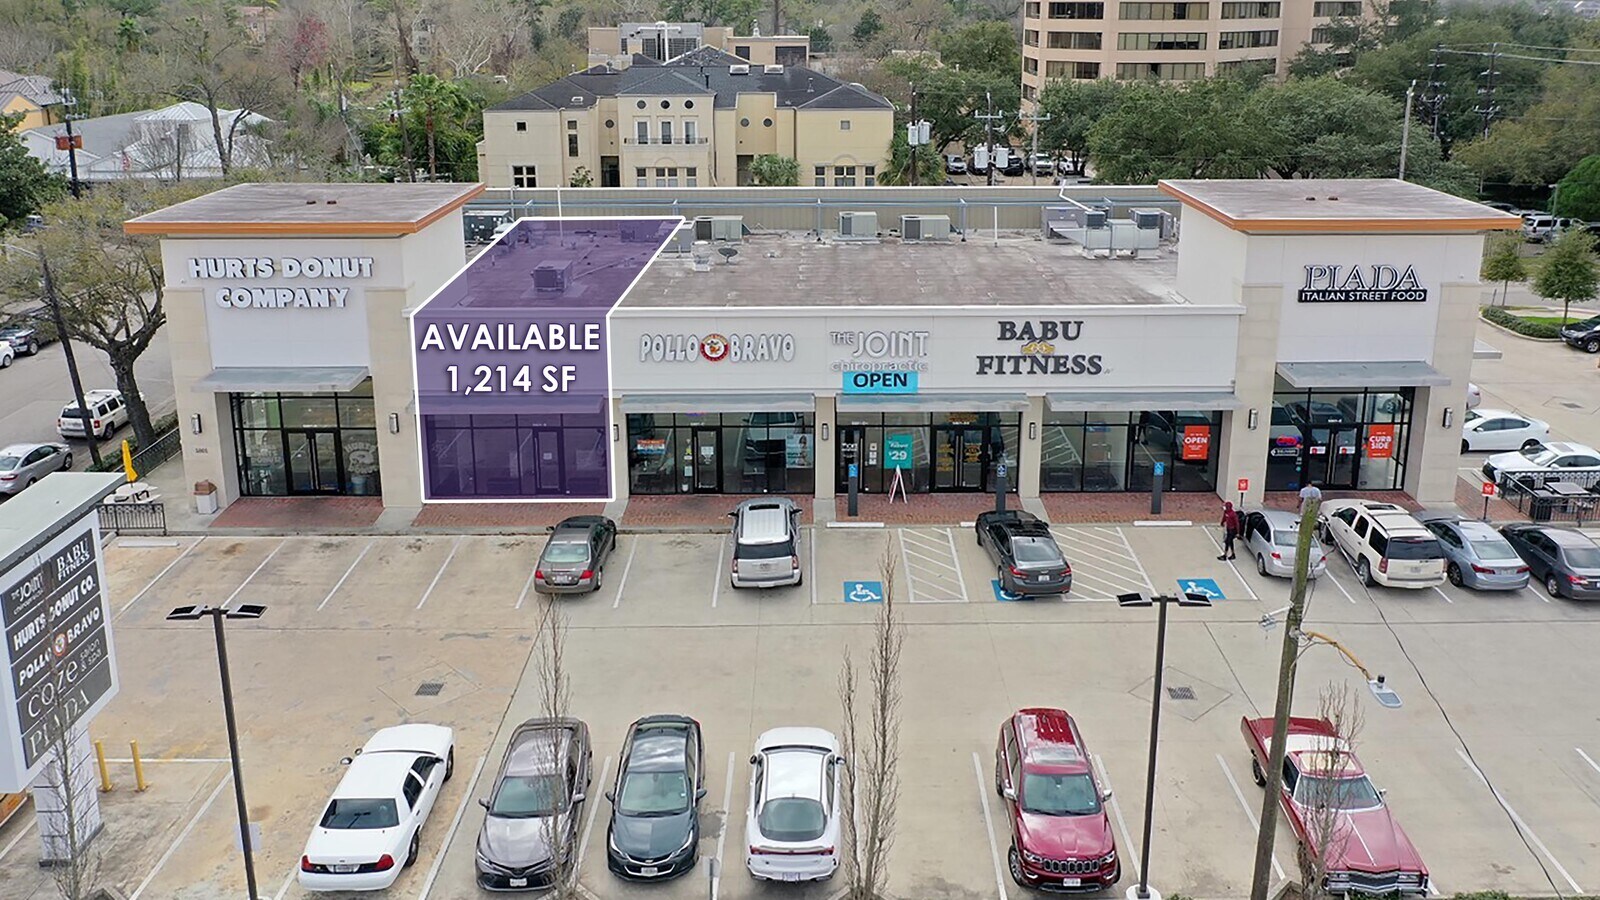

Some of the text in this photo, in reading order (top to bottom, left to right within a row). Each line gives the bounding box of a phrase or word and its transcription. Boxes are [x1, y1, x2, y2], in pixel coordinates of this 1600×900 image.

[188, 257, 374, 279] HURTS DONUT
[1302, 264, 1424, 291] PIADA
[216, 287, 349, 308] COMPANY
[1302, 291, 1425, 301] ITALIAN STREET FOOD
[830, 331, 854, 345] THE
[997, 321, 1084, 341] BABU
[640, 333, 795, 362] POLLO BRAVO
[831, 360, 928, 372] chiropractic
[976, 355, 1102, 375] FITNESS
[853, 373, 908, 388] OPEN
[57, 538, 88, 571] BABU
[58, 552, 90, 581] FITNESS
[19, 573, 44, 602] JOINT
[14, 613, 46, 651] HURTS
[81, 575, 96, 595] CO.
[66, 607, 100, 643] BRAVO
